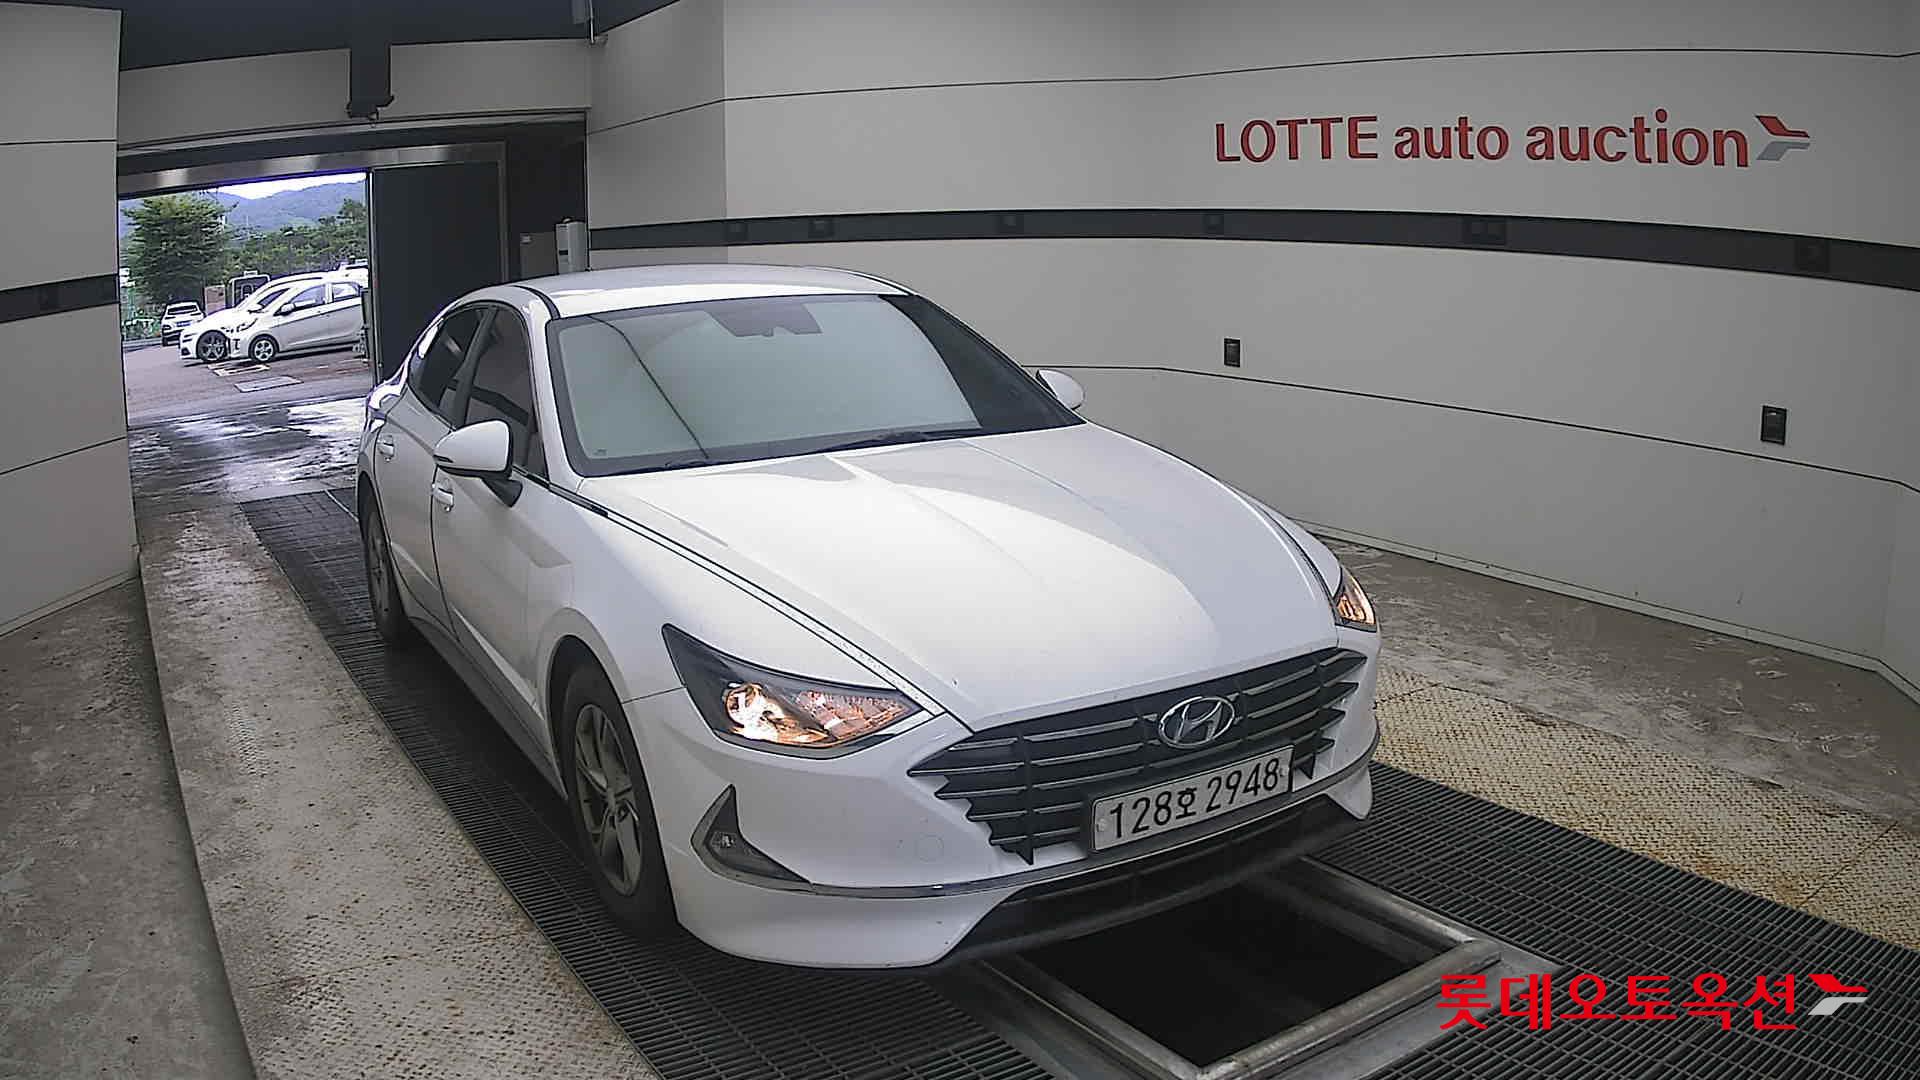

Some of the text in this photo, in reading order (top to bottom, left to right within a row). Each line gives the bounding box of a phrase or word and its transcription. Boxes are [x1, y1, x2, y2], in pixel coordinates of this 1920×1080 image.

[1215, 108, 1750, 168] LOTTE auto auction
[1109, 757, 1280, 839] 128호 2948
